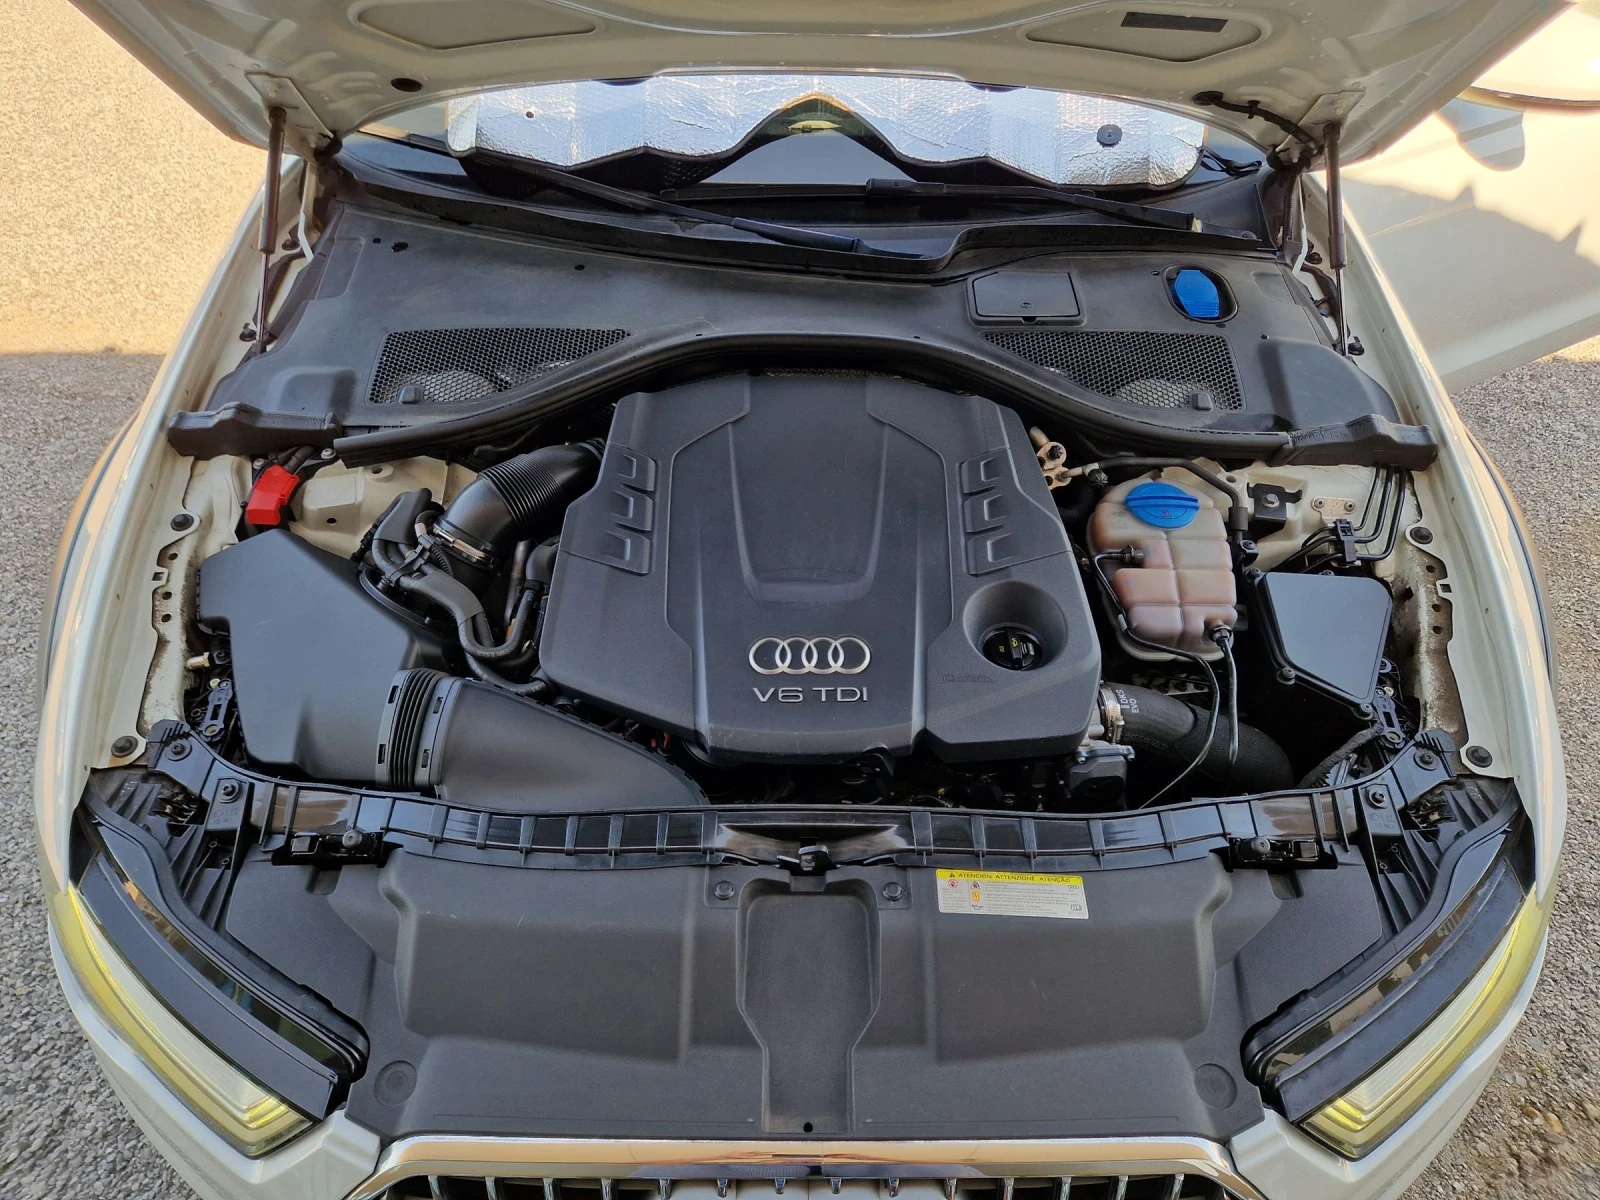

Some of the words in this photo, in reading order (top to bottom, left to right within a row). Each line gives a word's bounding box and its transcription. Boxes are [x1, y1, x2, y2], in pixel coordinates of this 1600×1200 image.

[752, 687, 803, 702] V6
[812, 687, 868, 702] TDI
[1129, 698, 1140, 714] EVO
[1039, 876, 1072, 884] ATENÇÃO
